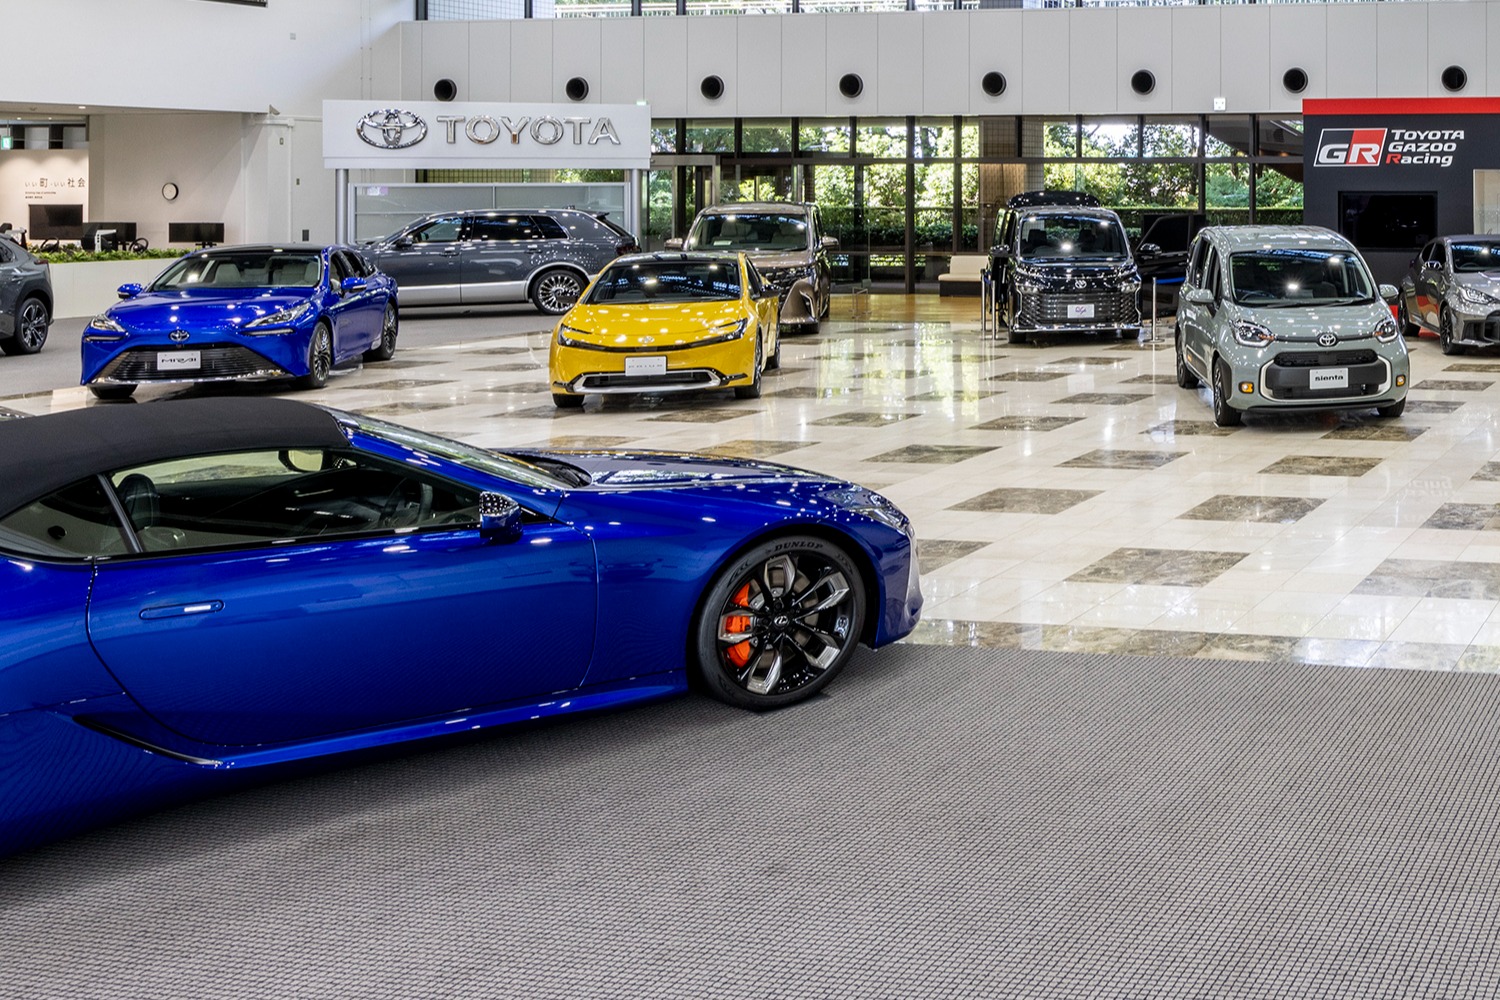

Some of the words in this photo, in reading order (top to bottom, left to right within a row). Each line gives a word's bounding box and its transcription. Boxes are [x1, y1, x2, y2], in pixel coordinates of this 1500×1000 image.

[437, 115, 621, 145] TOYOTA
[1391, 129, 1464, 140] TOYOTA
[1318, 143, 1380, 163] GR
[1388, 142, 1457, 152] GAZOO
[1386, 153, 1453, 167] Racing
[774, 541, 823, 552] DUNLOP
